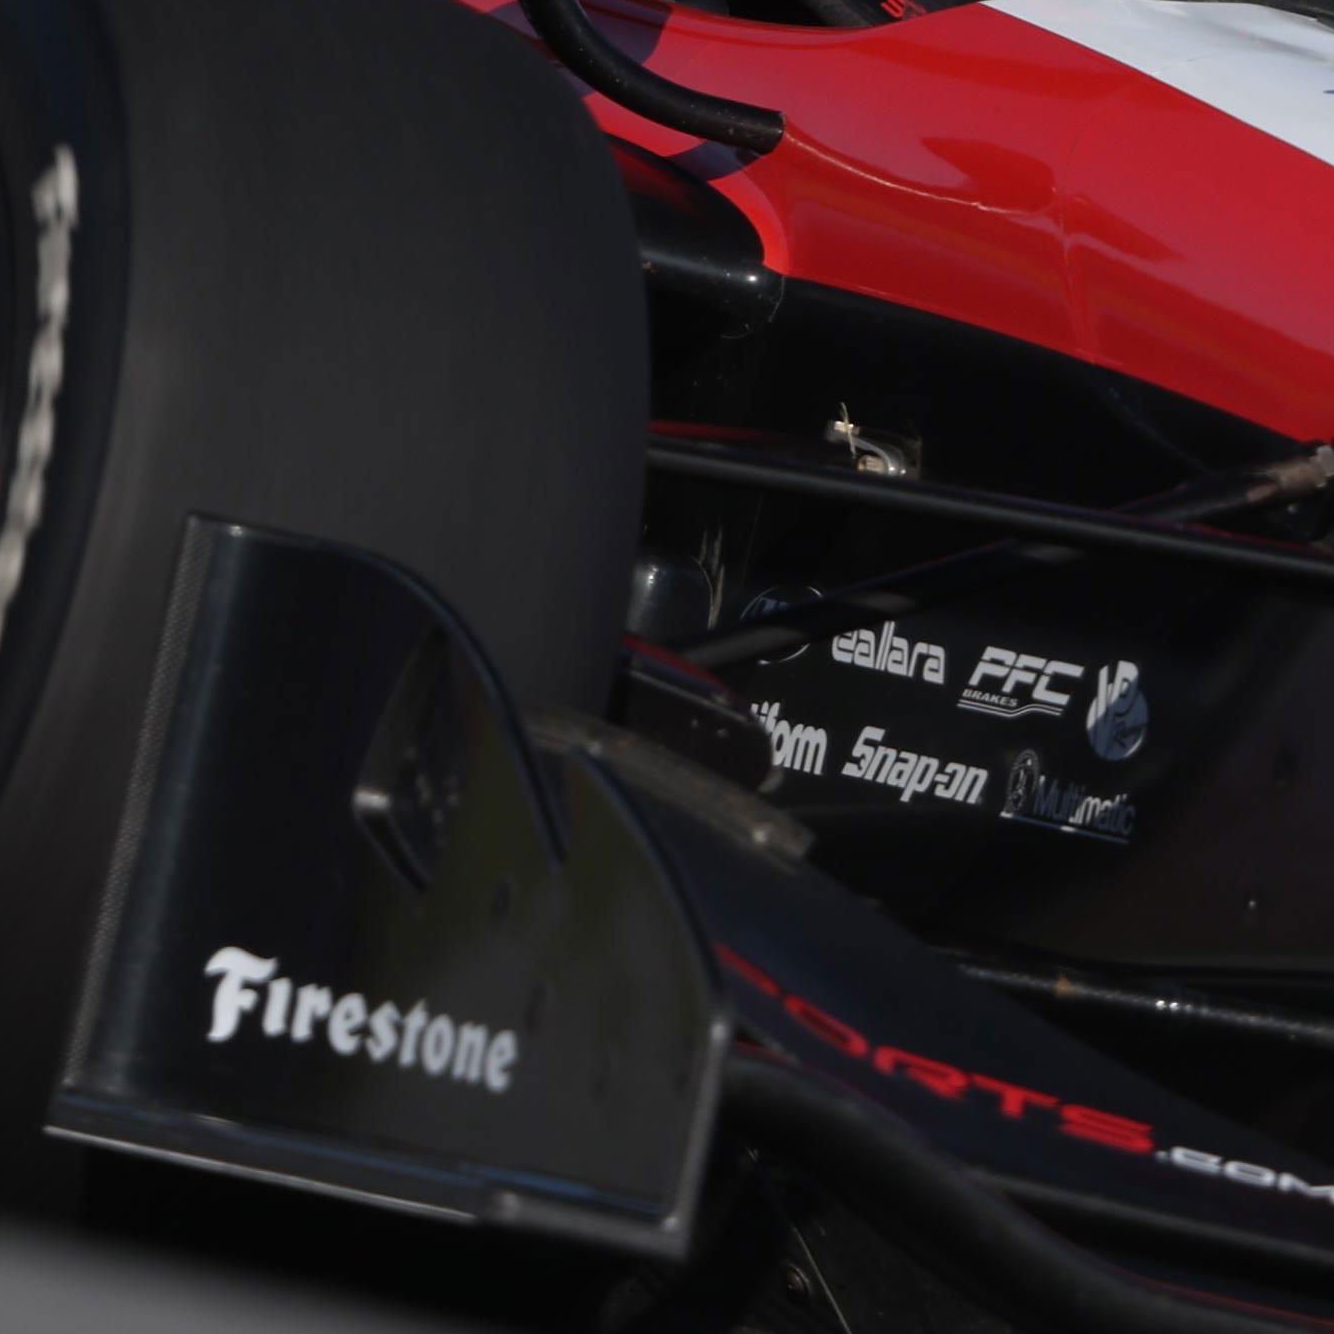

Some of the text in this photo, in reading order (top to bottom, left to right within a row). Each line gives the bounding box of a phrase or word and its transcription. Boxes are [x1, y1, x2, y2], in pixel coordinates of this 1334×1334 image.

[961, 688, 1020, 709] BRAKES
[968, 646, 1085, 706] PFC
[841, 725, 989, 803] Snap-on
[1033, 774, 1138, 836] Multimatic
[204, 946, 518, 1092] Firestone
